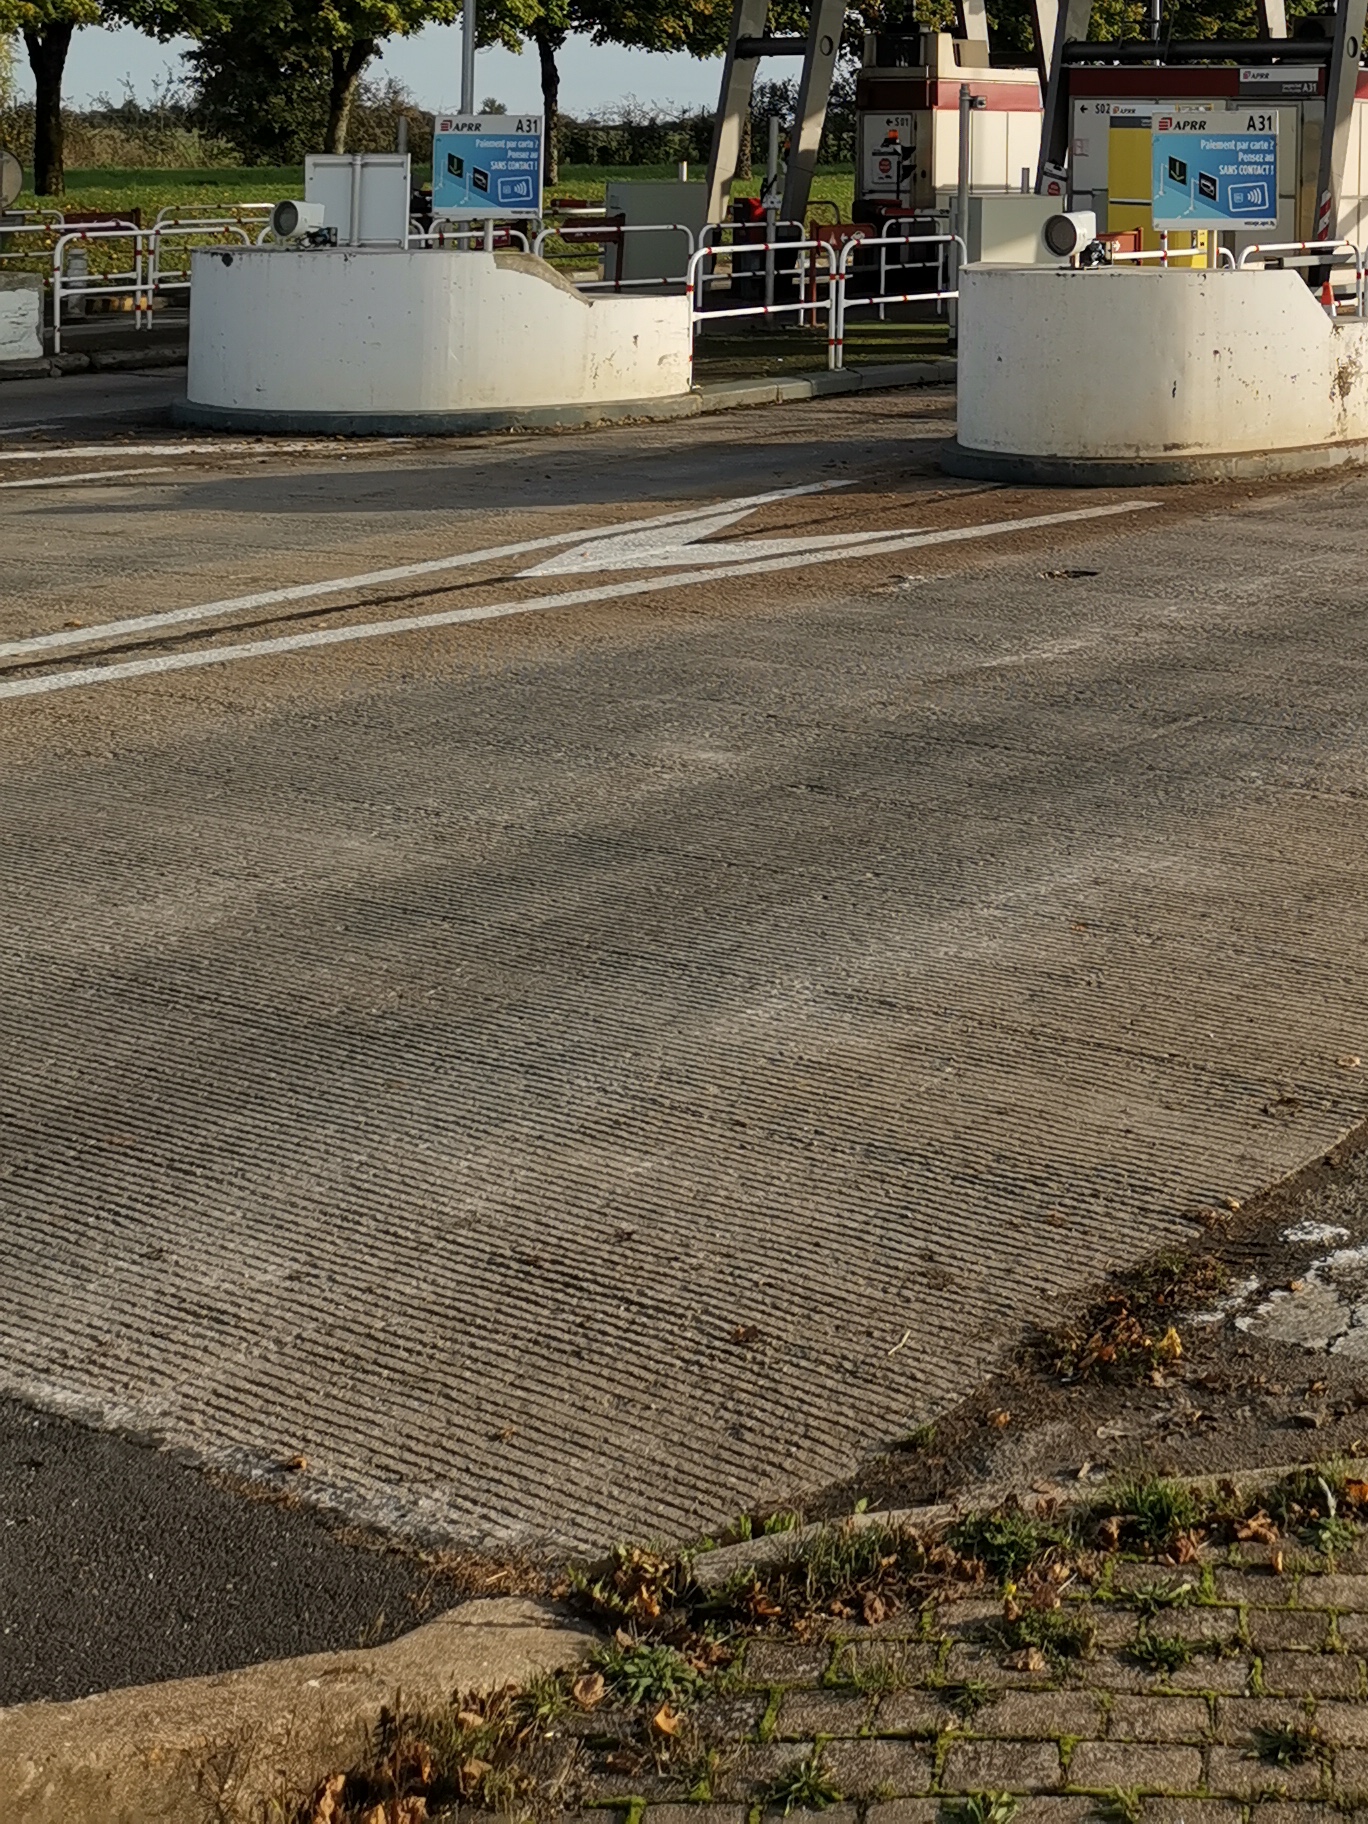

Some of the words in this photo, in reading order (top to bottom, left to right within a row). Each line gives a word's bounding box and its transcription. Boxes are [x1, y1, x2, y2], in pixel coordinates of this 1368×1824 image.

[1303, 83, 1317, 93] A31
[1095, 103, 1110, 114] S02
[515, 119, 538, 133] A31
[895, 117, 909, 126] S01
[1173, 120, 1207, 130] APRR
[1247, 115, 1272, 131] A31
[453, 122, 482, 132] APRR
[475, 139, 506, 148] Paiement
[506, 140, 517, 149] par
[518, 140, 533, 148] carte
[1200, 139, 1235, 150] Paiement
[1236, 141, 1249, 151] par
[1250, 141, 1268, 150] carte
[507, 150, 529, 158] Pensez
[1238, 152, 1263, 162] Pensez
[1265, 154, 1274, 162] au
[490, 161, 507, 170] SANS
[508, 161, 534, 170] CONTACT
[1219, 165, 1238, 175] SANS
[1239, 165, 1269, 175] CONTACT
